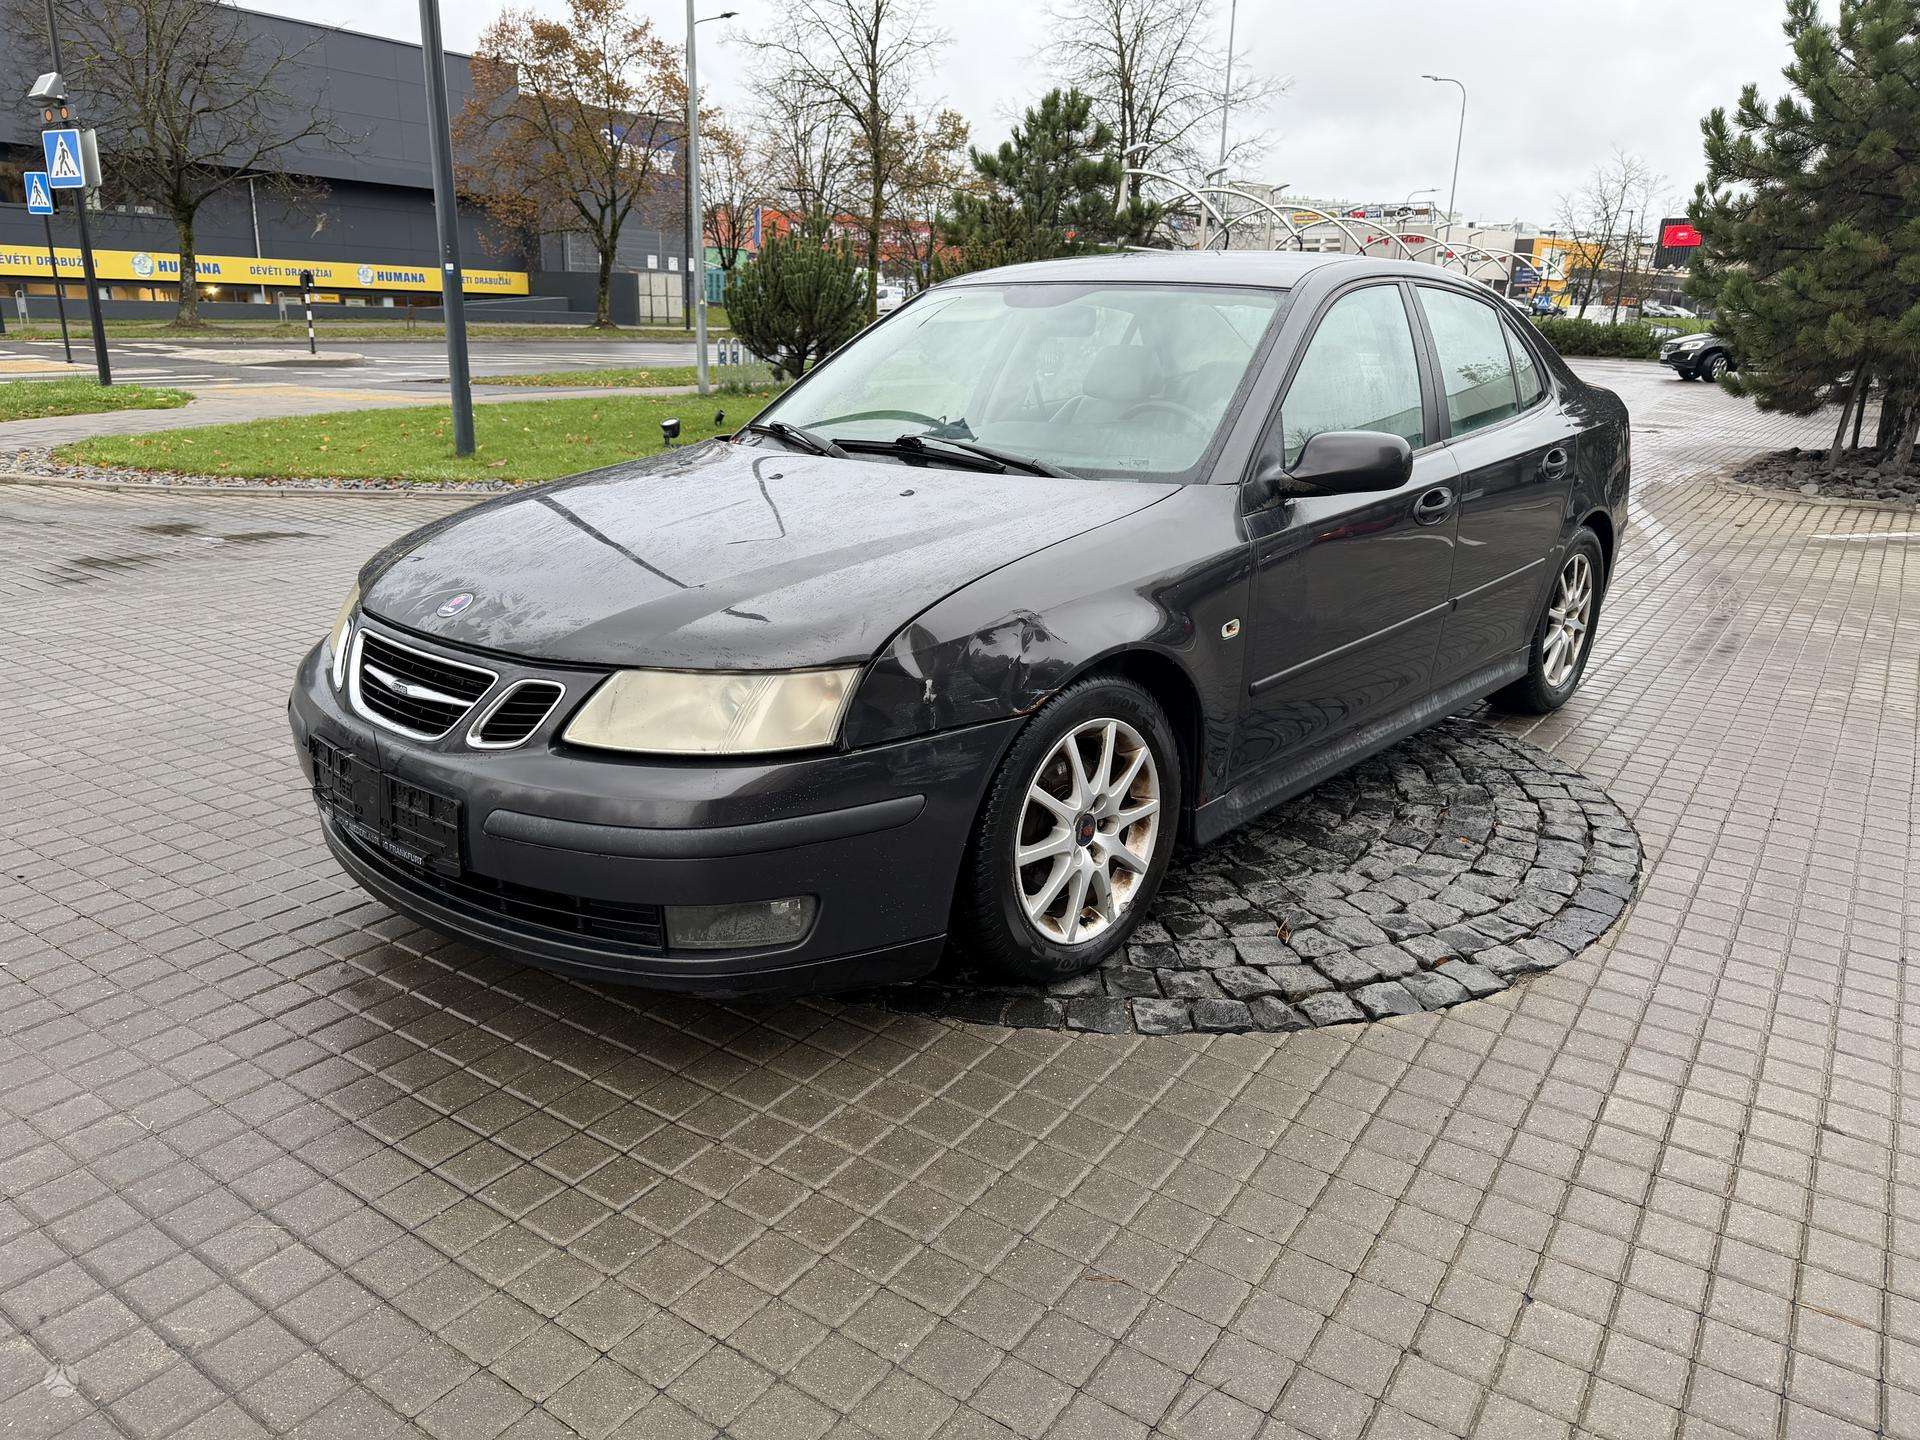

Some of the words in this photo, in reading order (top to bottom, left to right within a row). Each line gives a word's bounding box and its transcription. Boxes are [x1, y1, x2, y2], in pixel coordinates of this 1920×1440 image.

[157, 260, 221, 275] HUANA
[249, 265, 282, 277] DĖVĖTI
[284, 267, 332, 279] DRAUŽIAI
[376, 271, 426, 284] HUMANA
